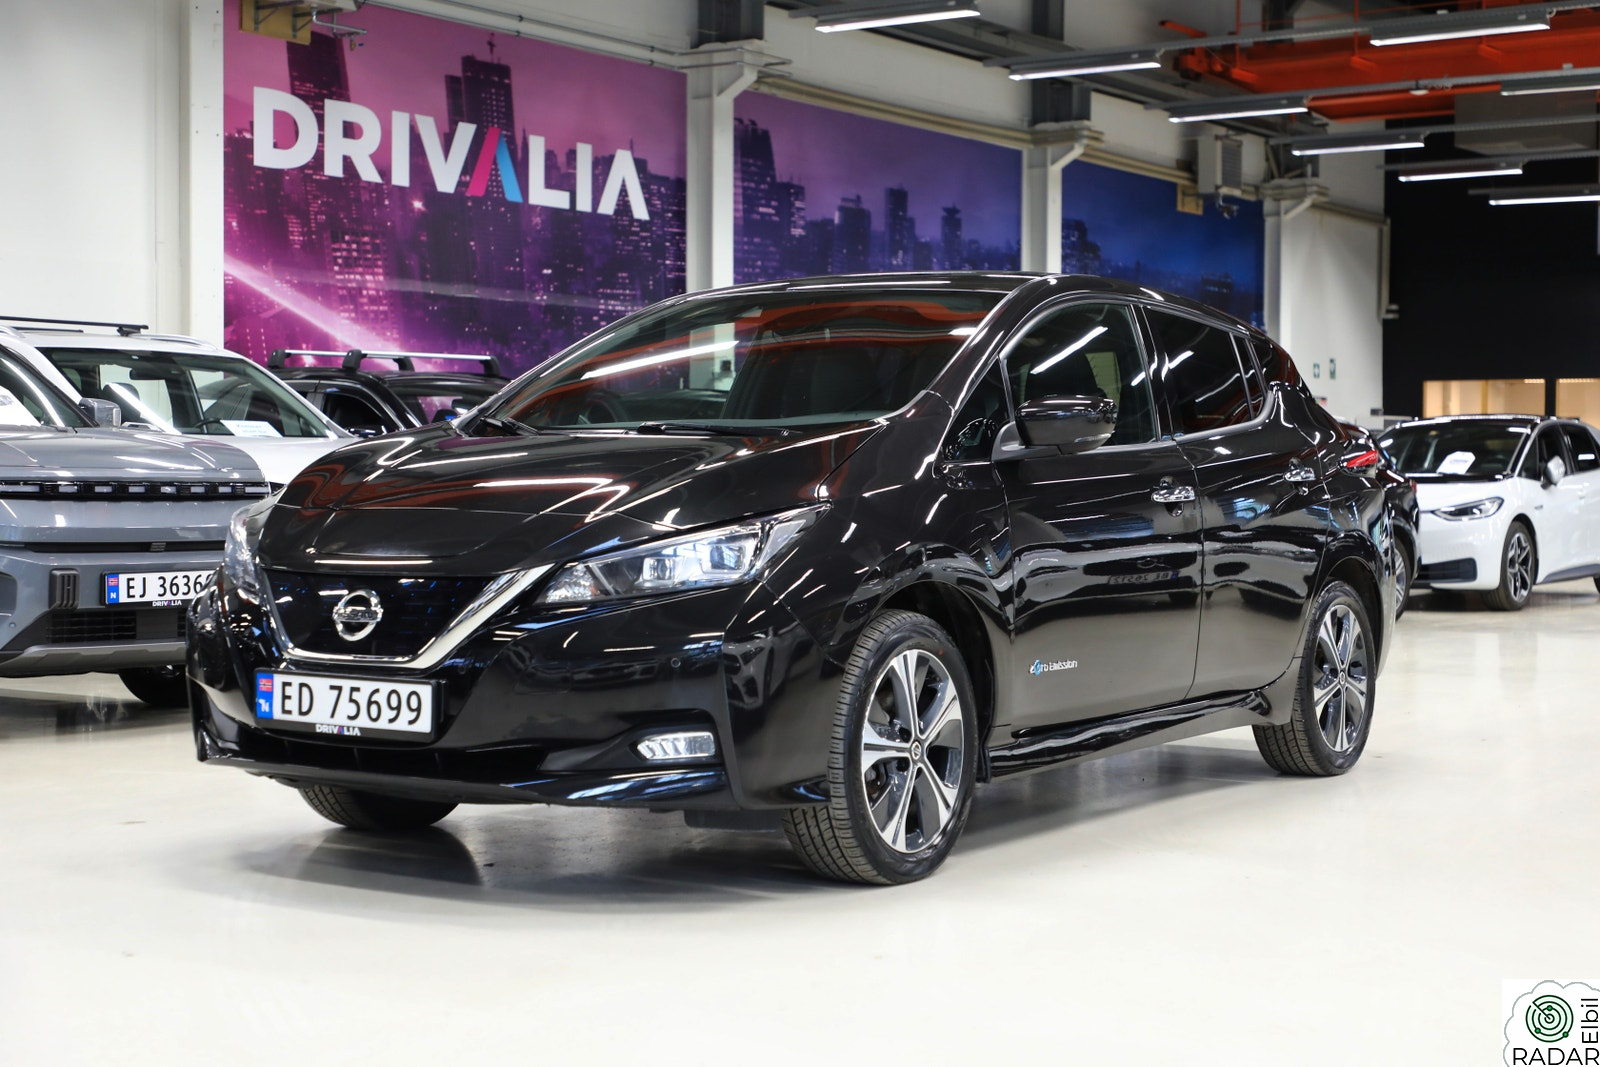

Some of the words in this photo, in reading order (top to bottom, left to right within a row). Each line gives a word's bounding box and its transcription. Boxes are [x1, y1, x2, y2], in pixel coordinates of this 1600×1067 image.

[253, 86, 650, 221] DRIVALIA
[126, 577, 146, 598] EJ
[281, 681, 314, 716] ED
[329, 685, 422, 726] 75699
[315, 723, 361, 737] DRIVALIA
